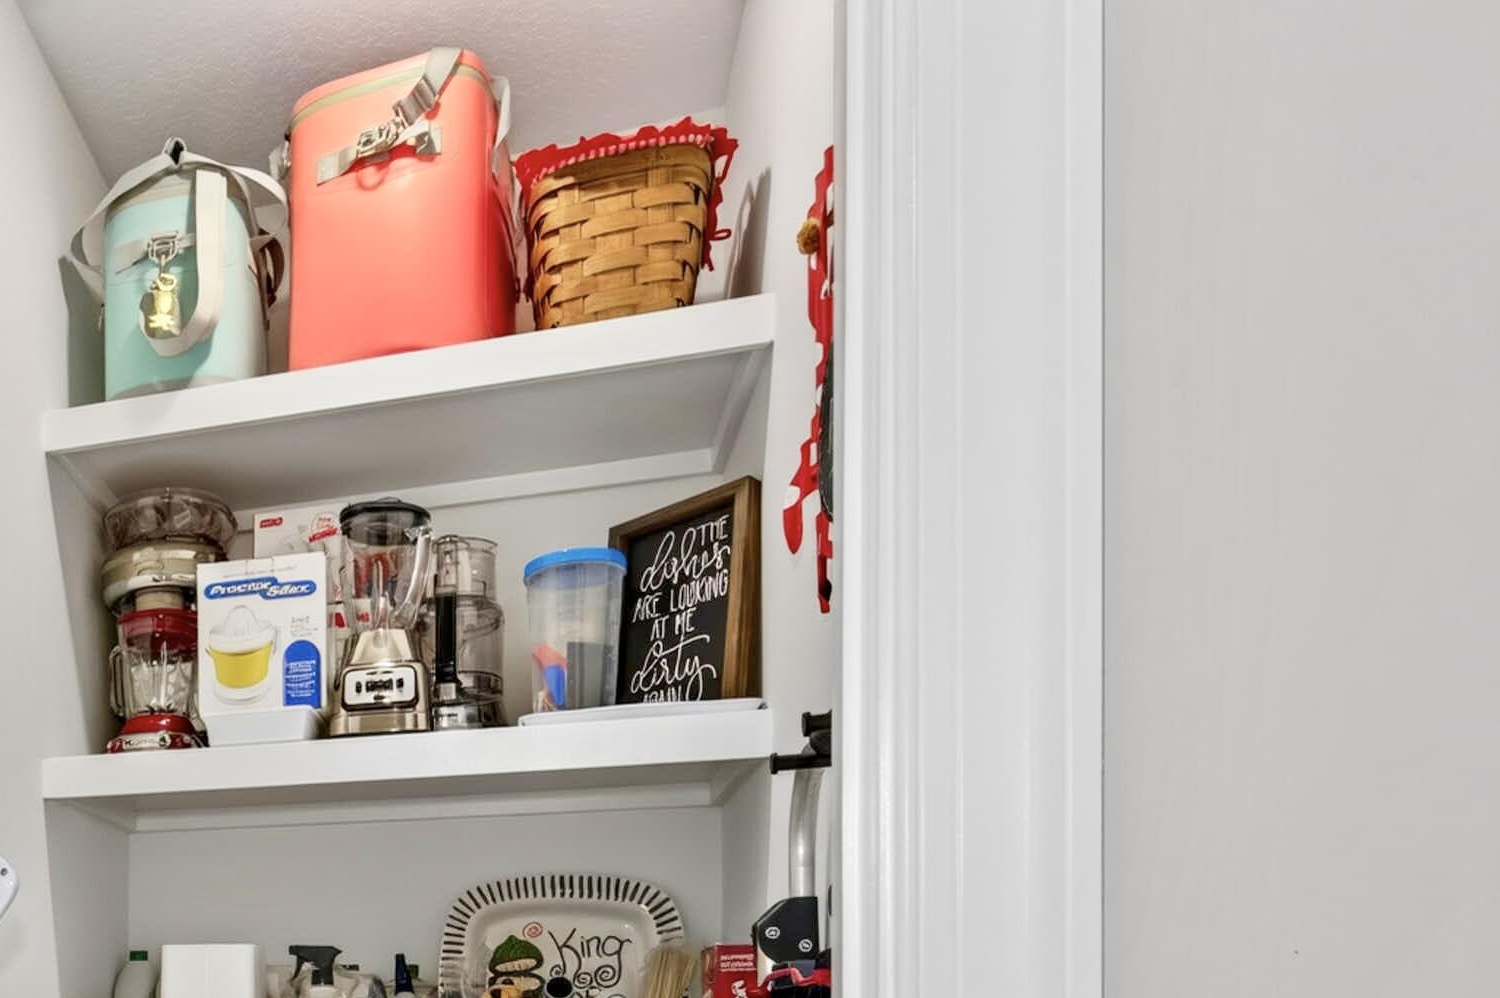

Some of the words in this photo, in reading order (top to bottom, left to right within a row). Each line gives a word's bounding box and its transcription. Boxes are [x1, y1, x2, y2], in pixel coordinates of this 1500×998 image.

[697, 514, 730, 546] THE
[640, 527, 731, 592] dishes
[632, 592, 663, 623] ARE
[670, 569, 729, 612] LOOKING
[651, 616, 669, 641] AT
[674, 607, 697, 635] ME
[631, 634, 717, 702] dirty
[547, 927, 633, 989] King
